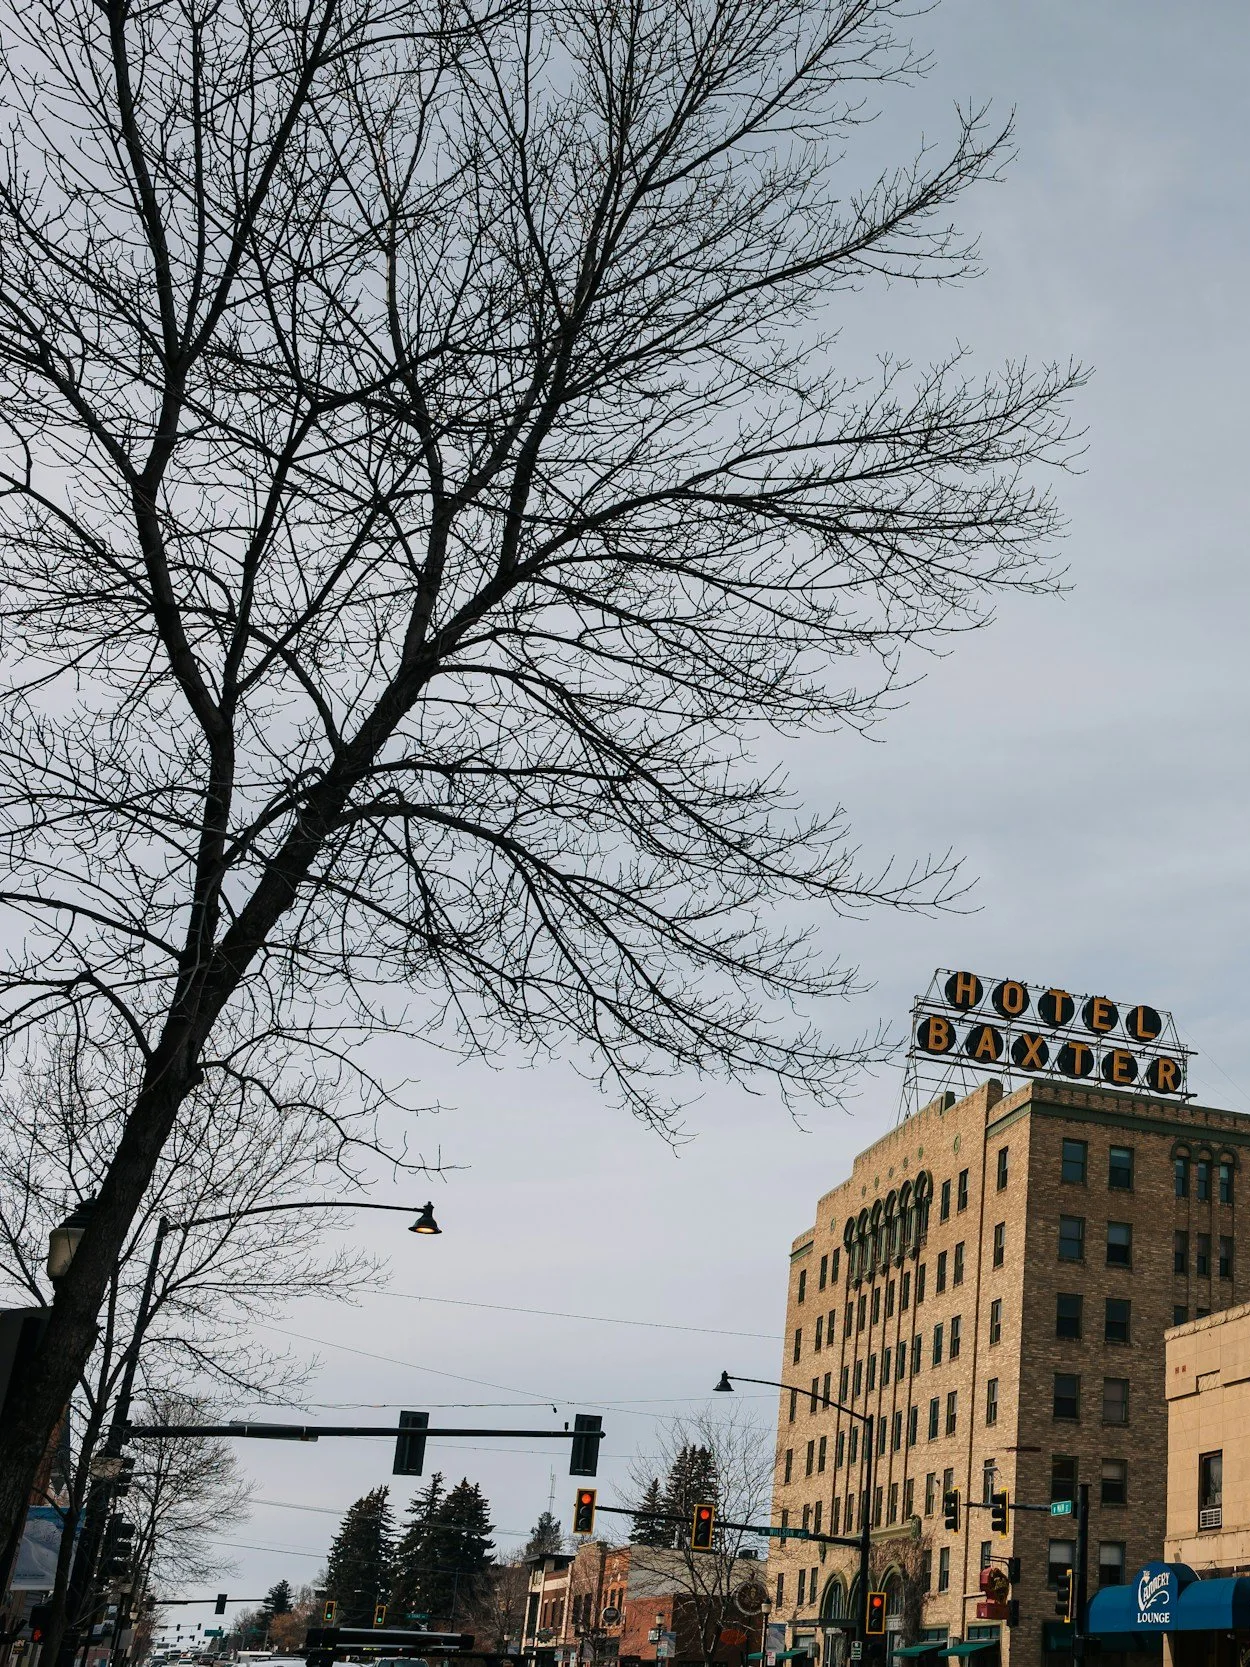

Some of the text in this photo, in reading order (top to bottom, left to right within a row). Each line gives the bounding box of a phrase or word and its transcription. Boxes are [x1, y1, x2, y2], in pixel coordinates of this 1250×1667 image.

[955, 971, 1156, 1038] HOTEL
[928, 1016, 1176, 1092] BAXTER
[769, 1528, 794, 1537] WILLSON
[1137, 1612, 1170, 1623] LOUNGE
